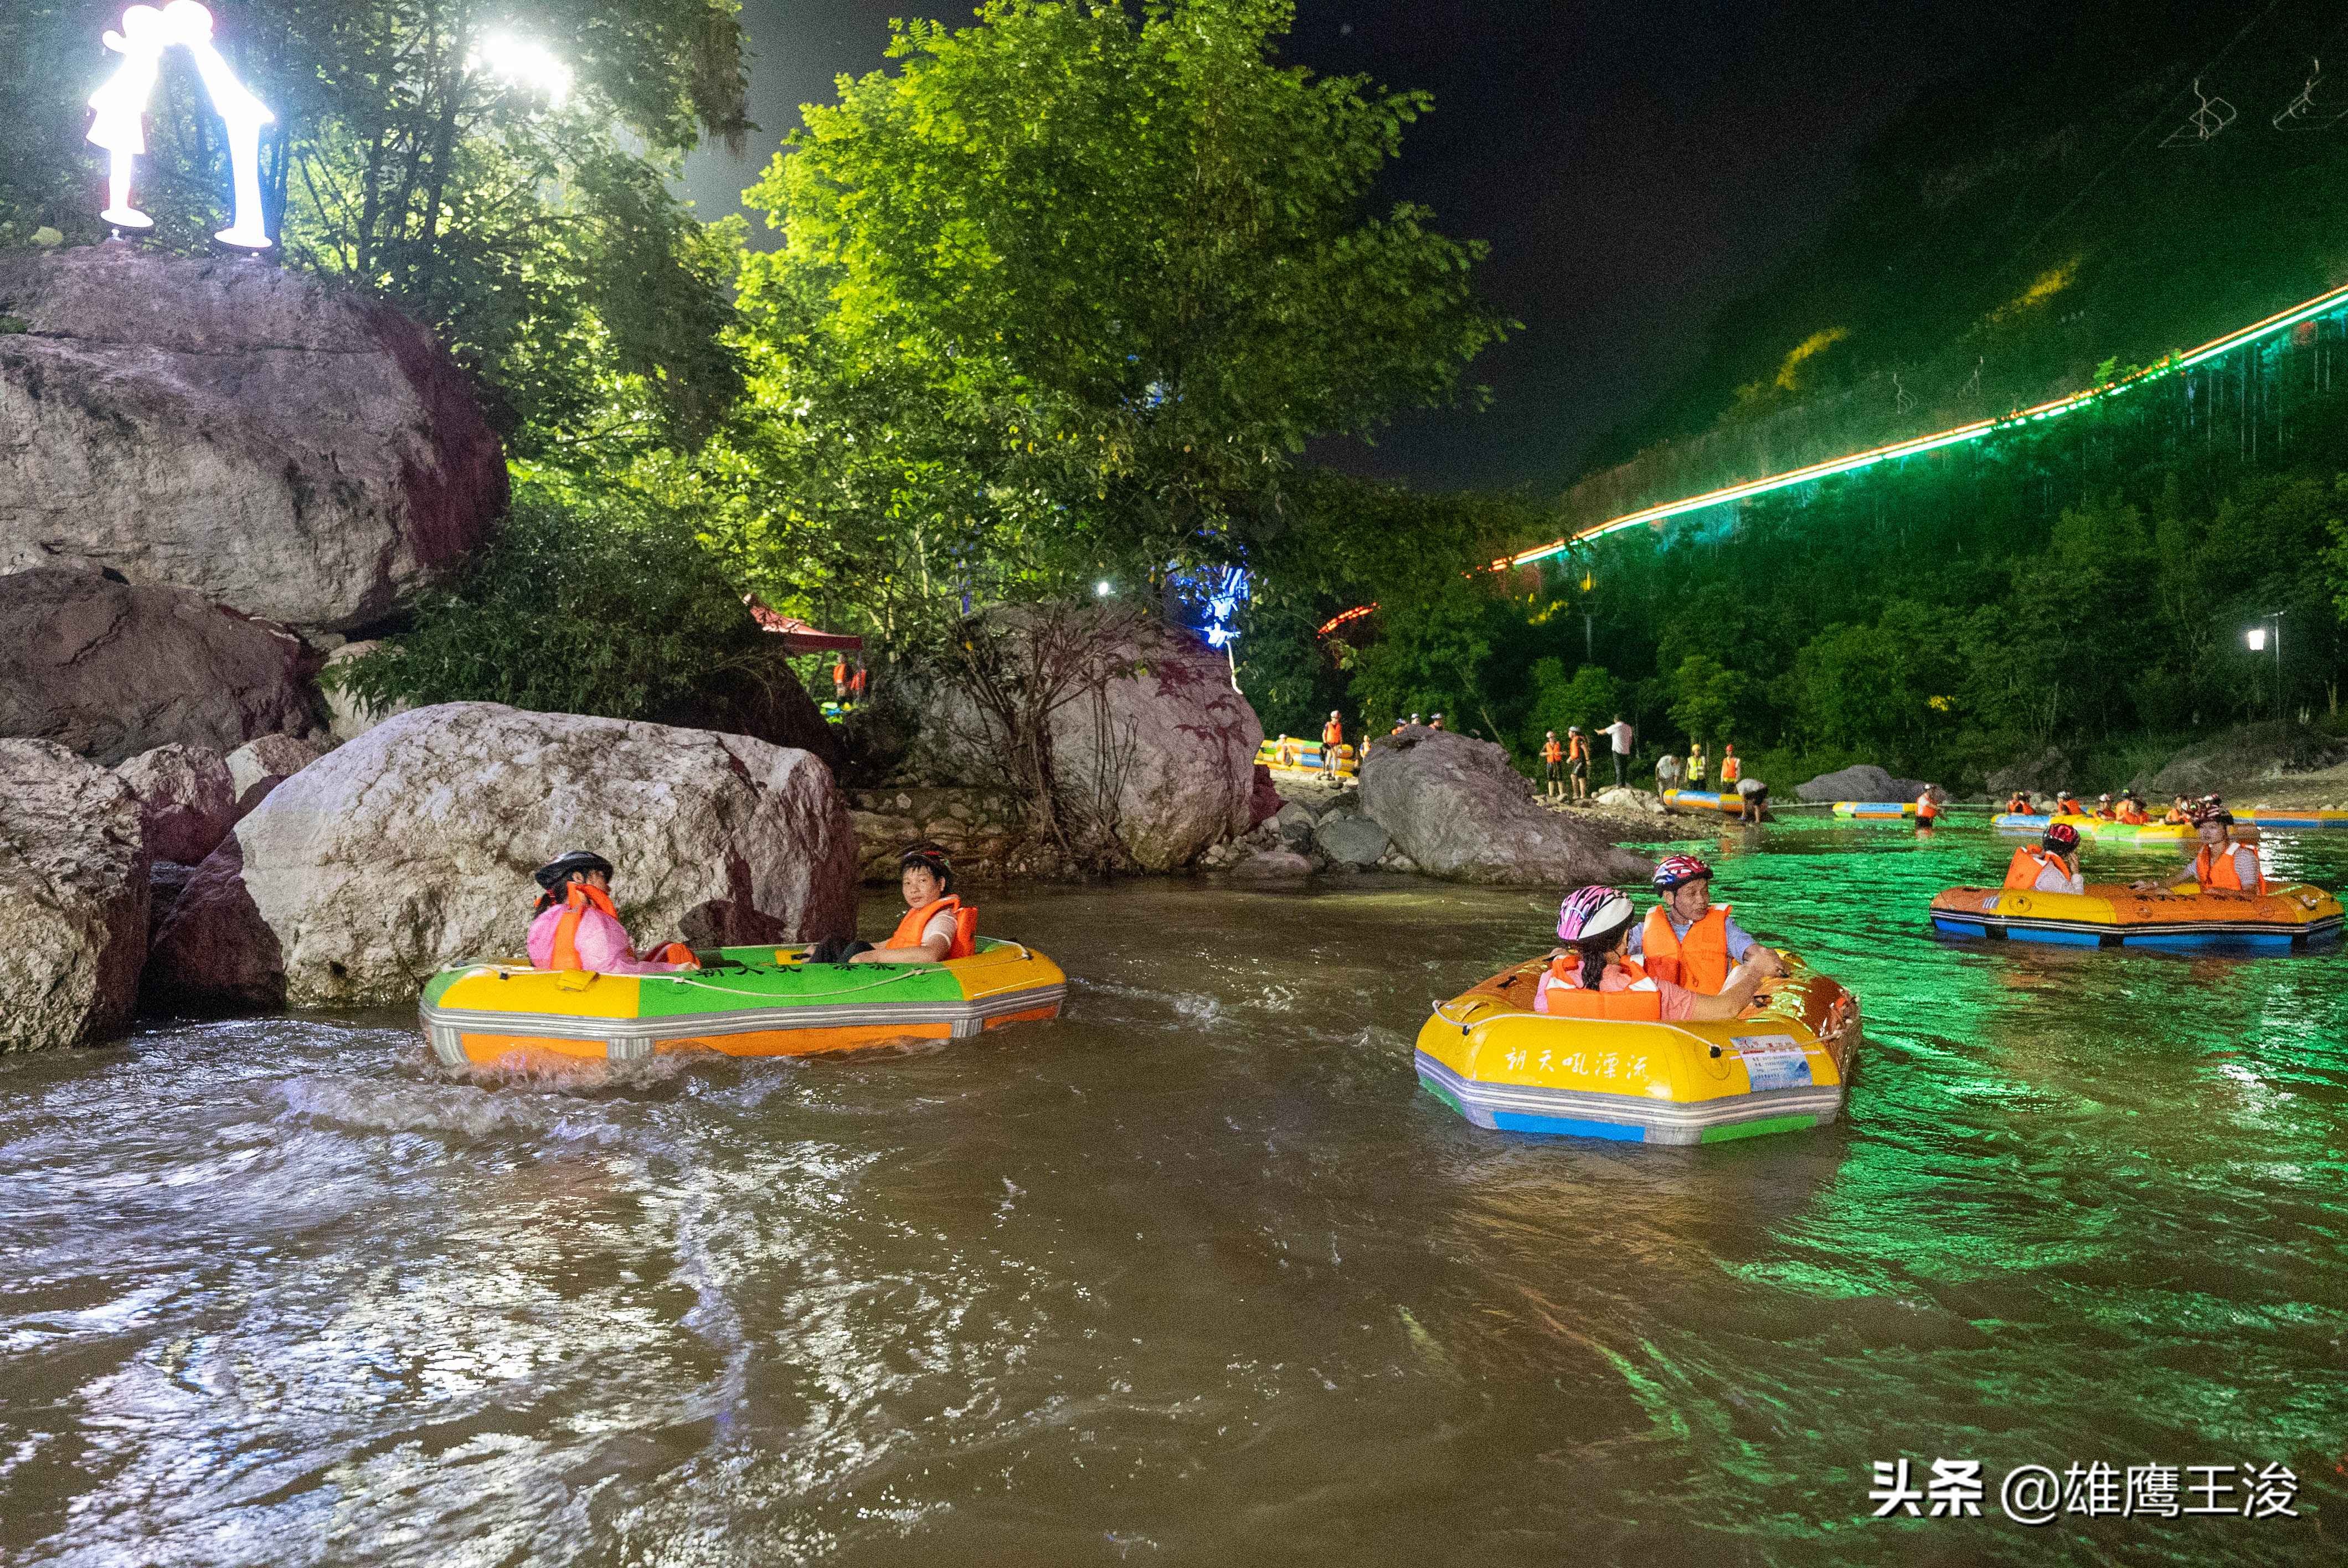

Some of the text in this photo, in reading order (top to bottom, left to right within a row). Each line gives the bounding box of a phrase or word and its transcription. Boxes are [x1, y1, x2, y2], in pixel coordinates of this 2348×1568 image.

[1505, 1047, 1649, 1080] 朝天吼漂流
